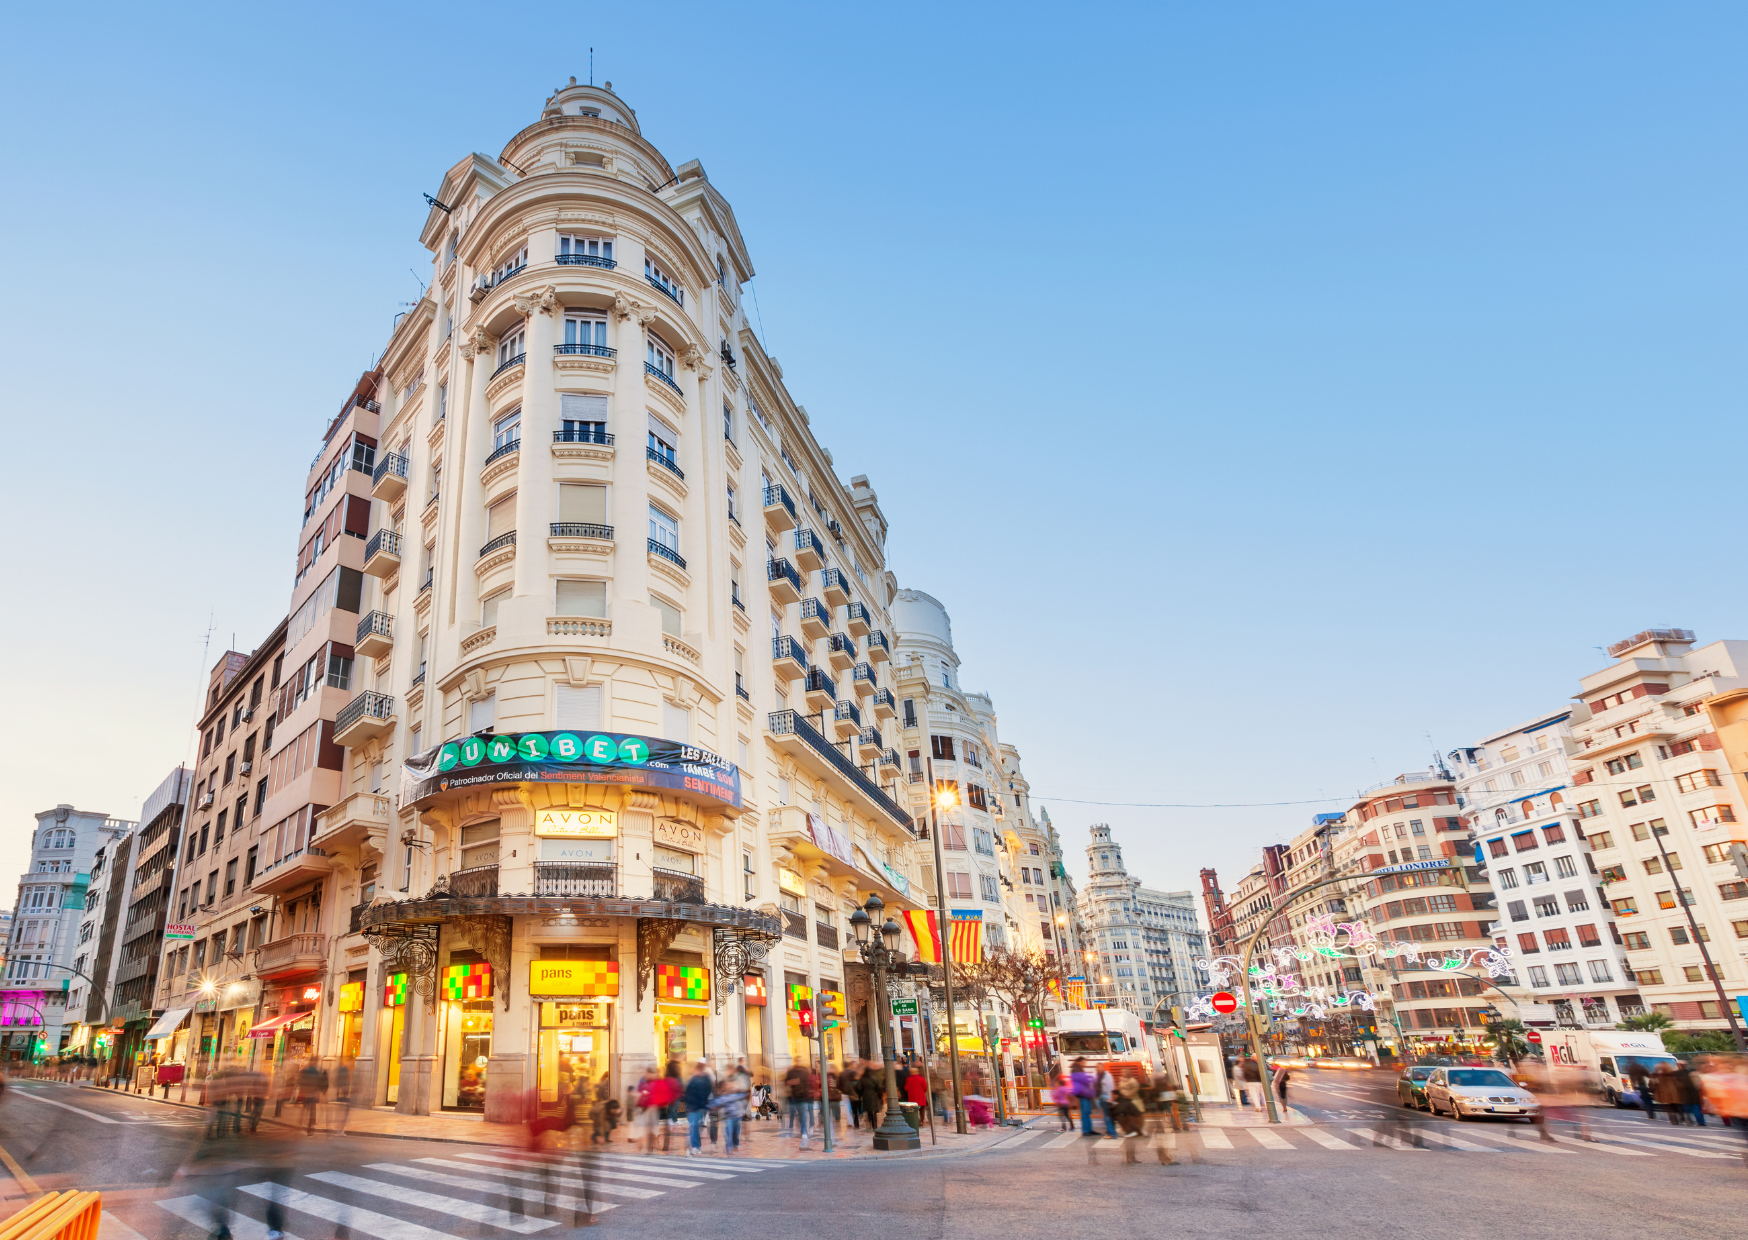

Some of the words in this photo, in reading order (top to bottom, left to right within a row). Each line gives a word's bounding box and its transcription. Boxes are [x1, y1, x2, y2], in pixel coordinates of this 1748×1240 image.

[466, 739, 640, 761] UNIBET
[646, 760, 669, 769] .com
[681, 745, 700, 760] LES
[701, 751, 730, 771] FALLES
[680, 762, 715, 780] TAMBÉ
[450, 774, 495, 786] Patrocinador
[496, 771, 523, 780] Oficial
[524, 771, 538, 779] del
[540, 771, 585, 780] Sentiment
[587, 772, 644, 783] Valencianista
[684, 776, 734, 802] SENTIMENT
[542, 813, 612, 824] AVON
[658, 822, 701, 842] AVON
[474, 852, 495, 862] AVON
[661, 855, 682, 865] AVON
[1399, 859, 1451, 872] LONDRES
[167, 923, 195, 931] HOSTAL
[541, 968, 572, 981] pans
[560, 1009, 594, 1023] pans
